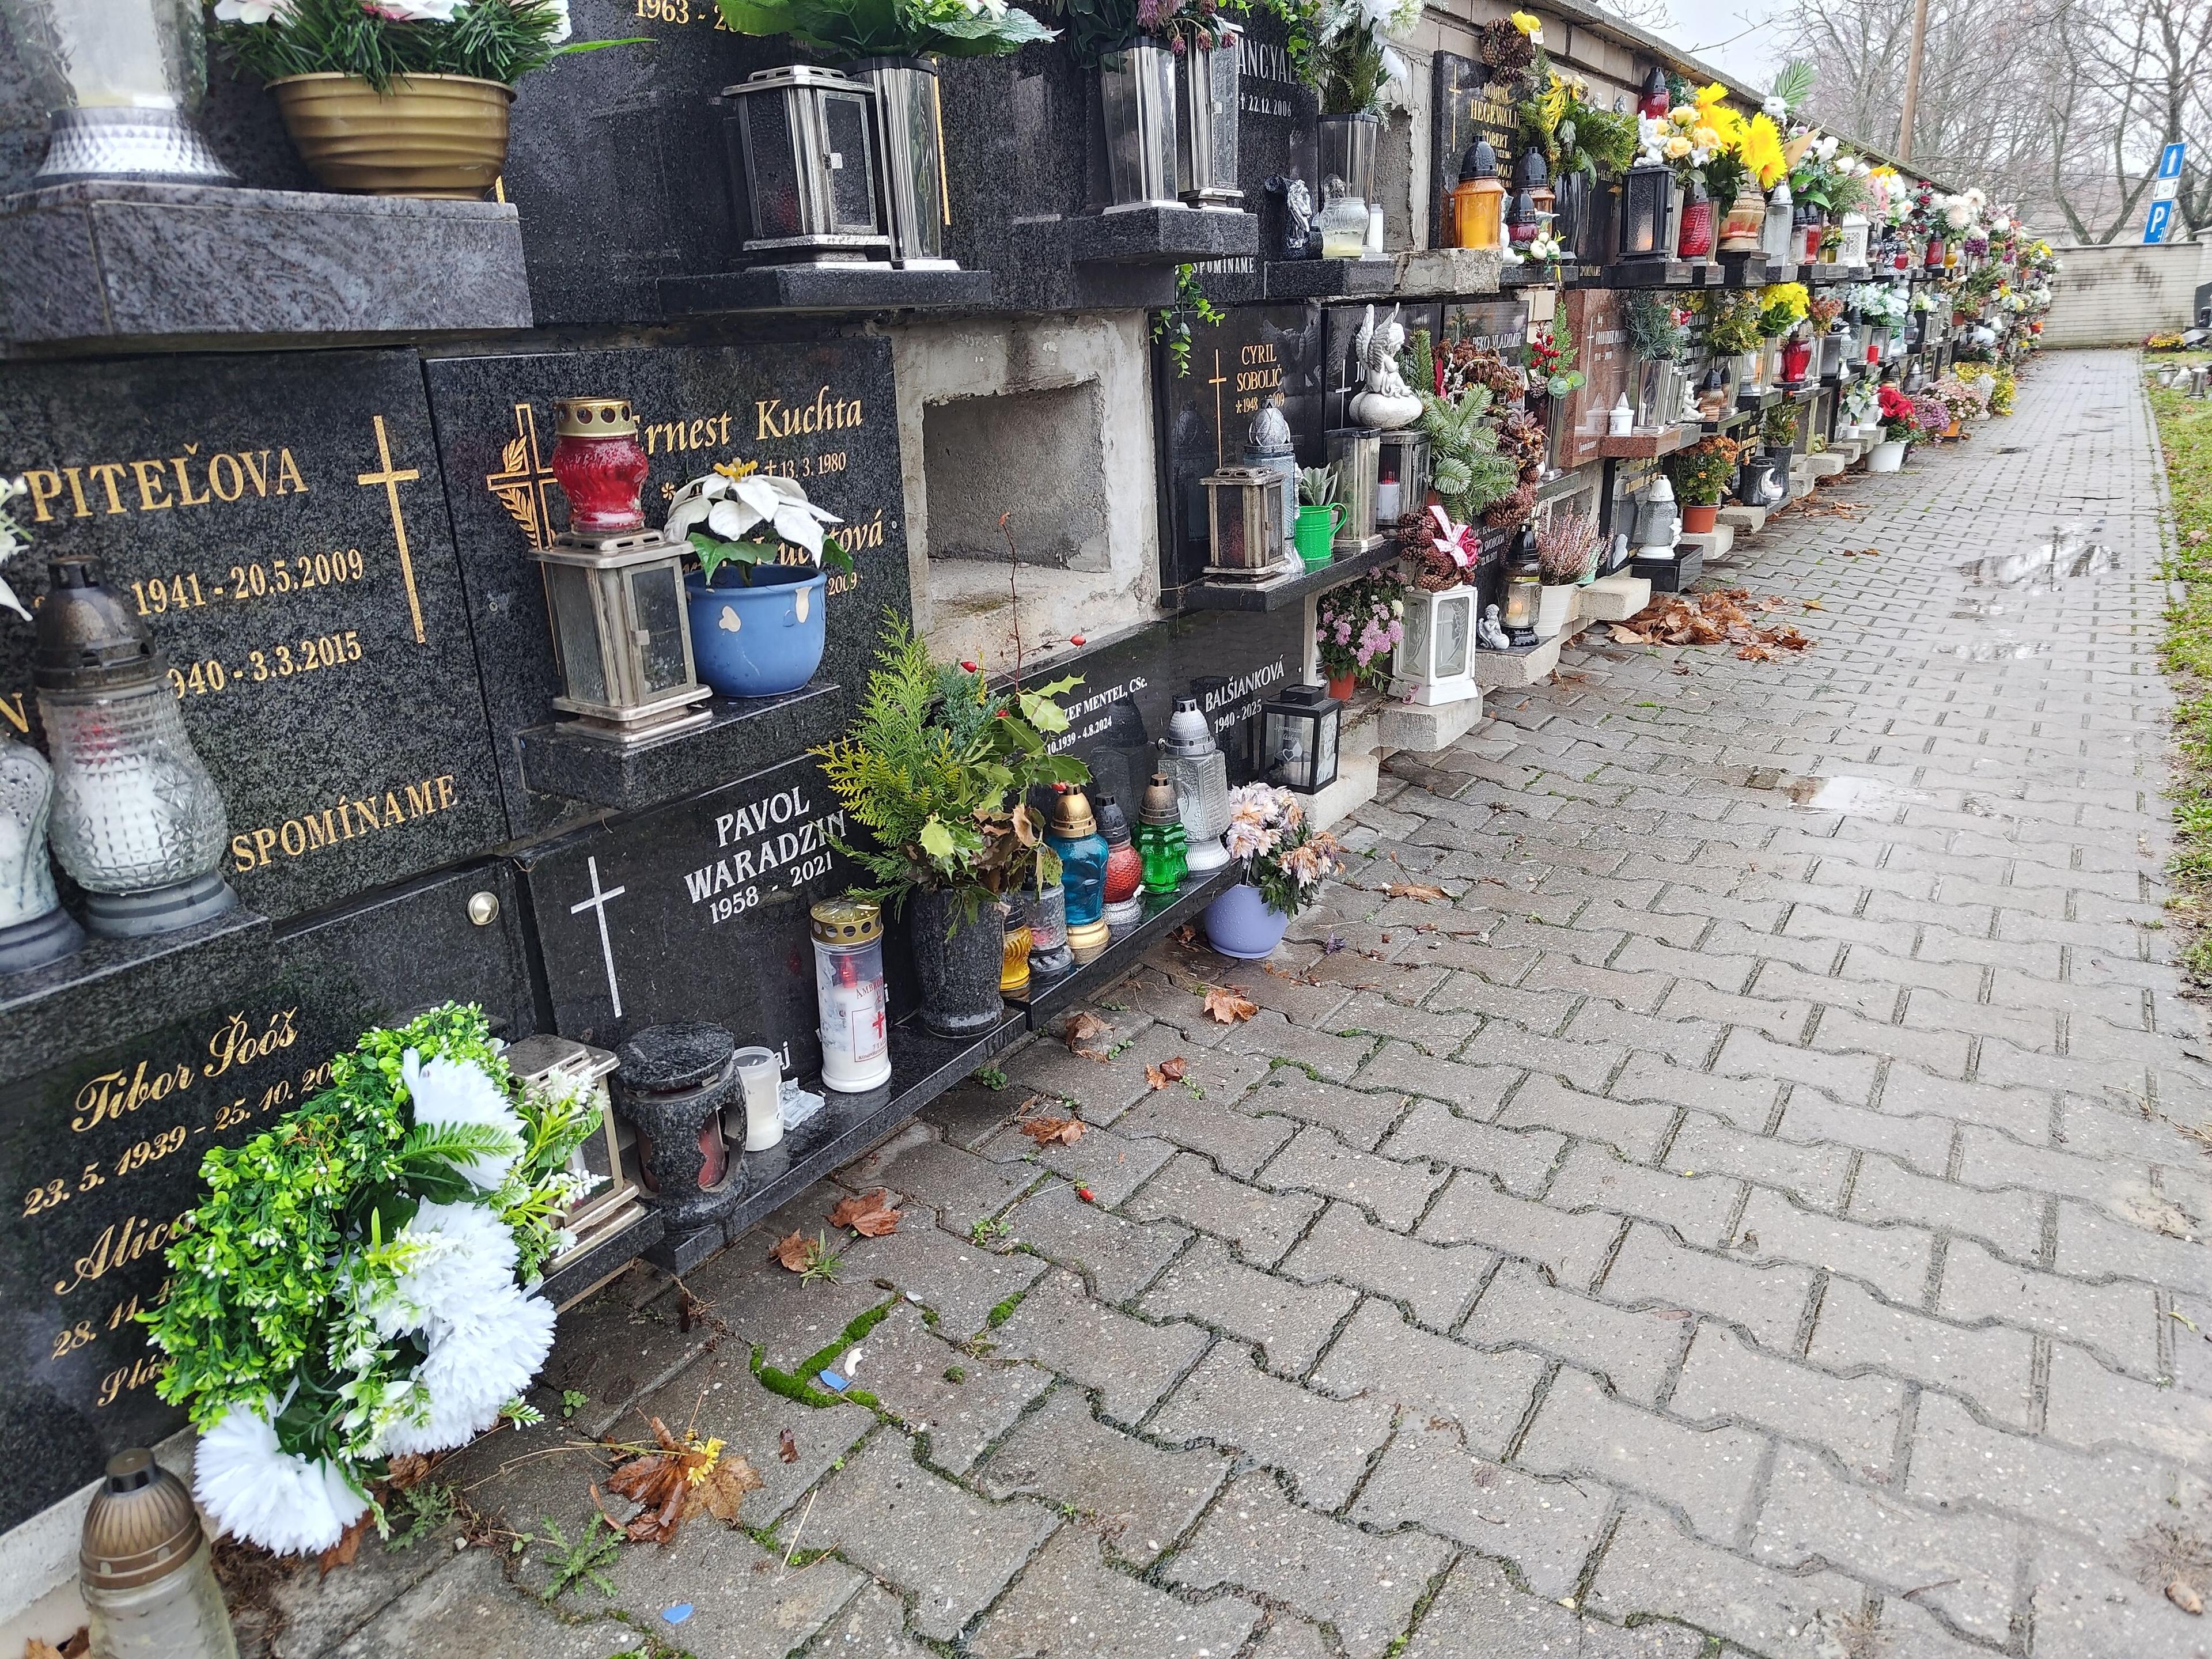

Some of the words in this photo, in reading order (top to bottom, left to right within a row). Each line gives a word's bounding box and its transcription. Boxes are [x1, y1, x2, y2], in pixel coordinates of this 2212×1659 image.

[2150, 207, 2165, 233] P
[1237, 363, 1282, 392] SOBOLIČ
[1241, 344, 1277, 365] CYRIL
[755, 385, 863, 441] Kuchta
[818, 452, 846, 475] 1980
[132, 572, 206, 615] 1941
[230, 548, 364, 600] 20.5.2009
[166, 658, 225, 699] 940
[249, 631, 362, 682] 3.3.2015
[1129, 676, 1147, 695] CSc.
[1206, 654, 1284, 713] BALŠIANKOVÁ
[1082, 715, 1112, 738] 4.8.2024
[1214, 711, 1234, 734] 1940
[1241, 698, 1262, 721] 2025
[232, 774, 458, 873] SPOMÍNAME
[715, 786, 810, 848] PAVOL
[709, 886, 759, 924] 1958
[790, 850, 833, 888] 2021
[70, 1060, 195, 1133] Tibor
[204, 1006, 299, 1077] Šoóš
[22, 1177, 70, 1218] 23.
[79, 1161, 105, 1192] 5.
[115, 1125, 186, 1176] 1939
[214, 1097, 251, 1133] 25.
[259, 1080, 294, 1112] 10.
[300, 1062, 332, 1094] 20
[51, 1319, 97, 1361] 28.
